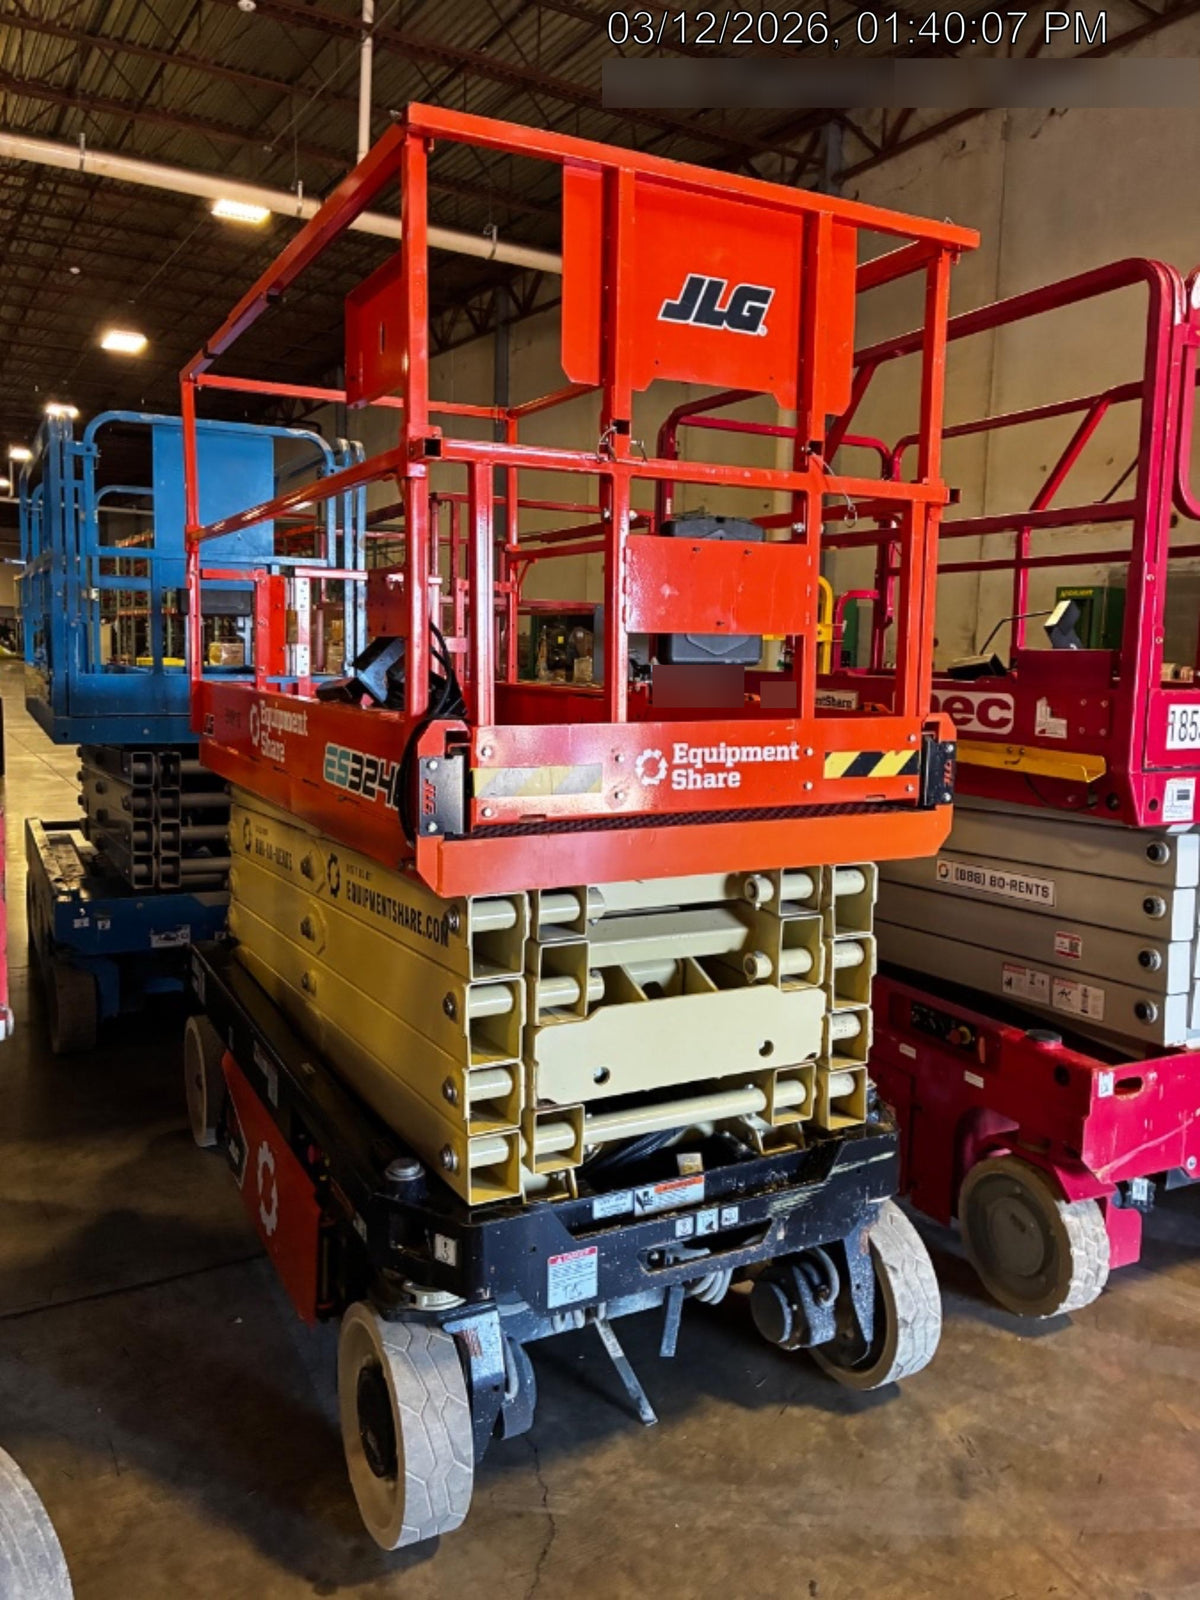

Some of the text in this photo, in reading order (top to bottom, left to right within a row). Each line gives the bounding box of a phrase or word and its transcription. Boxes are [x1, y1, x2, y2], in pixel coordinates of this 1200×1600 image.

[657, 272, 775, 335] JLG
[259, 699, 308, 736] Equipment
[1168, 710, 1200, 743] 185
[260, 730, 285, 763] Share
[671, 741, 800, 769] Equipment
[670, 768, 741, 791] Share
